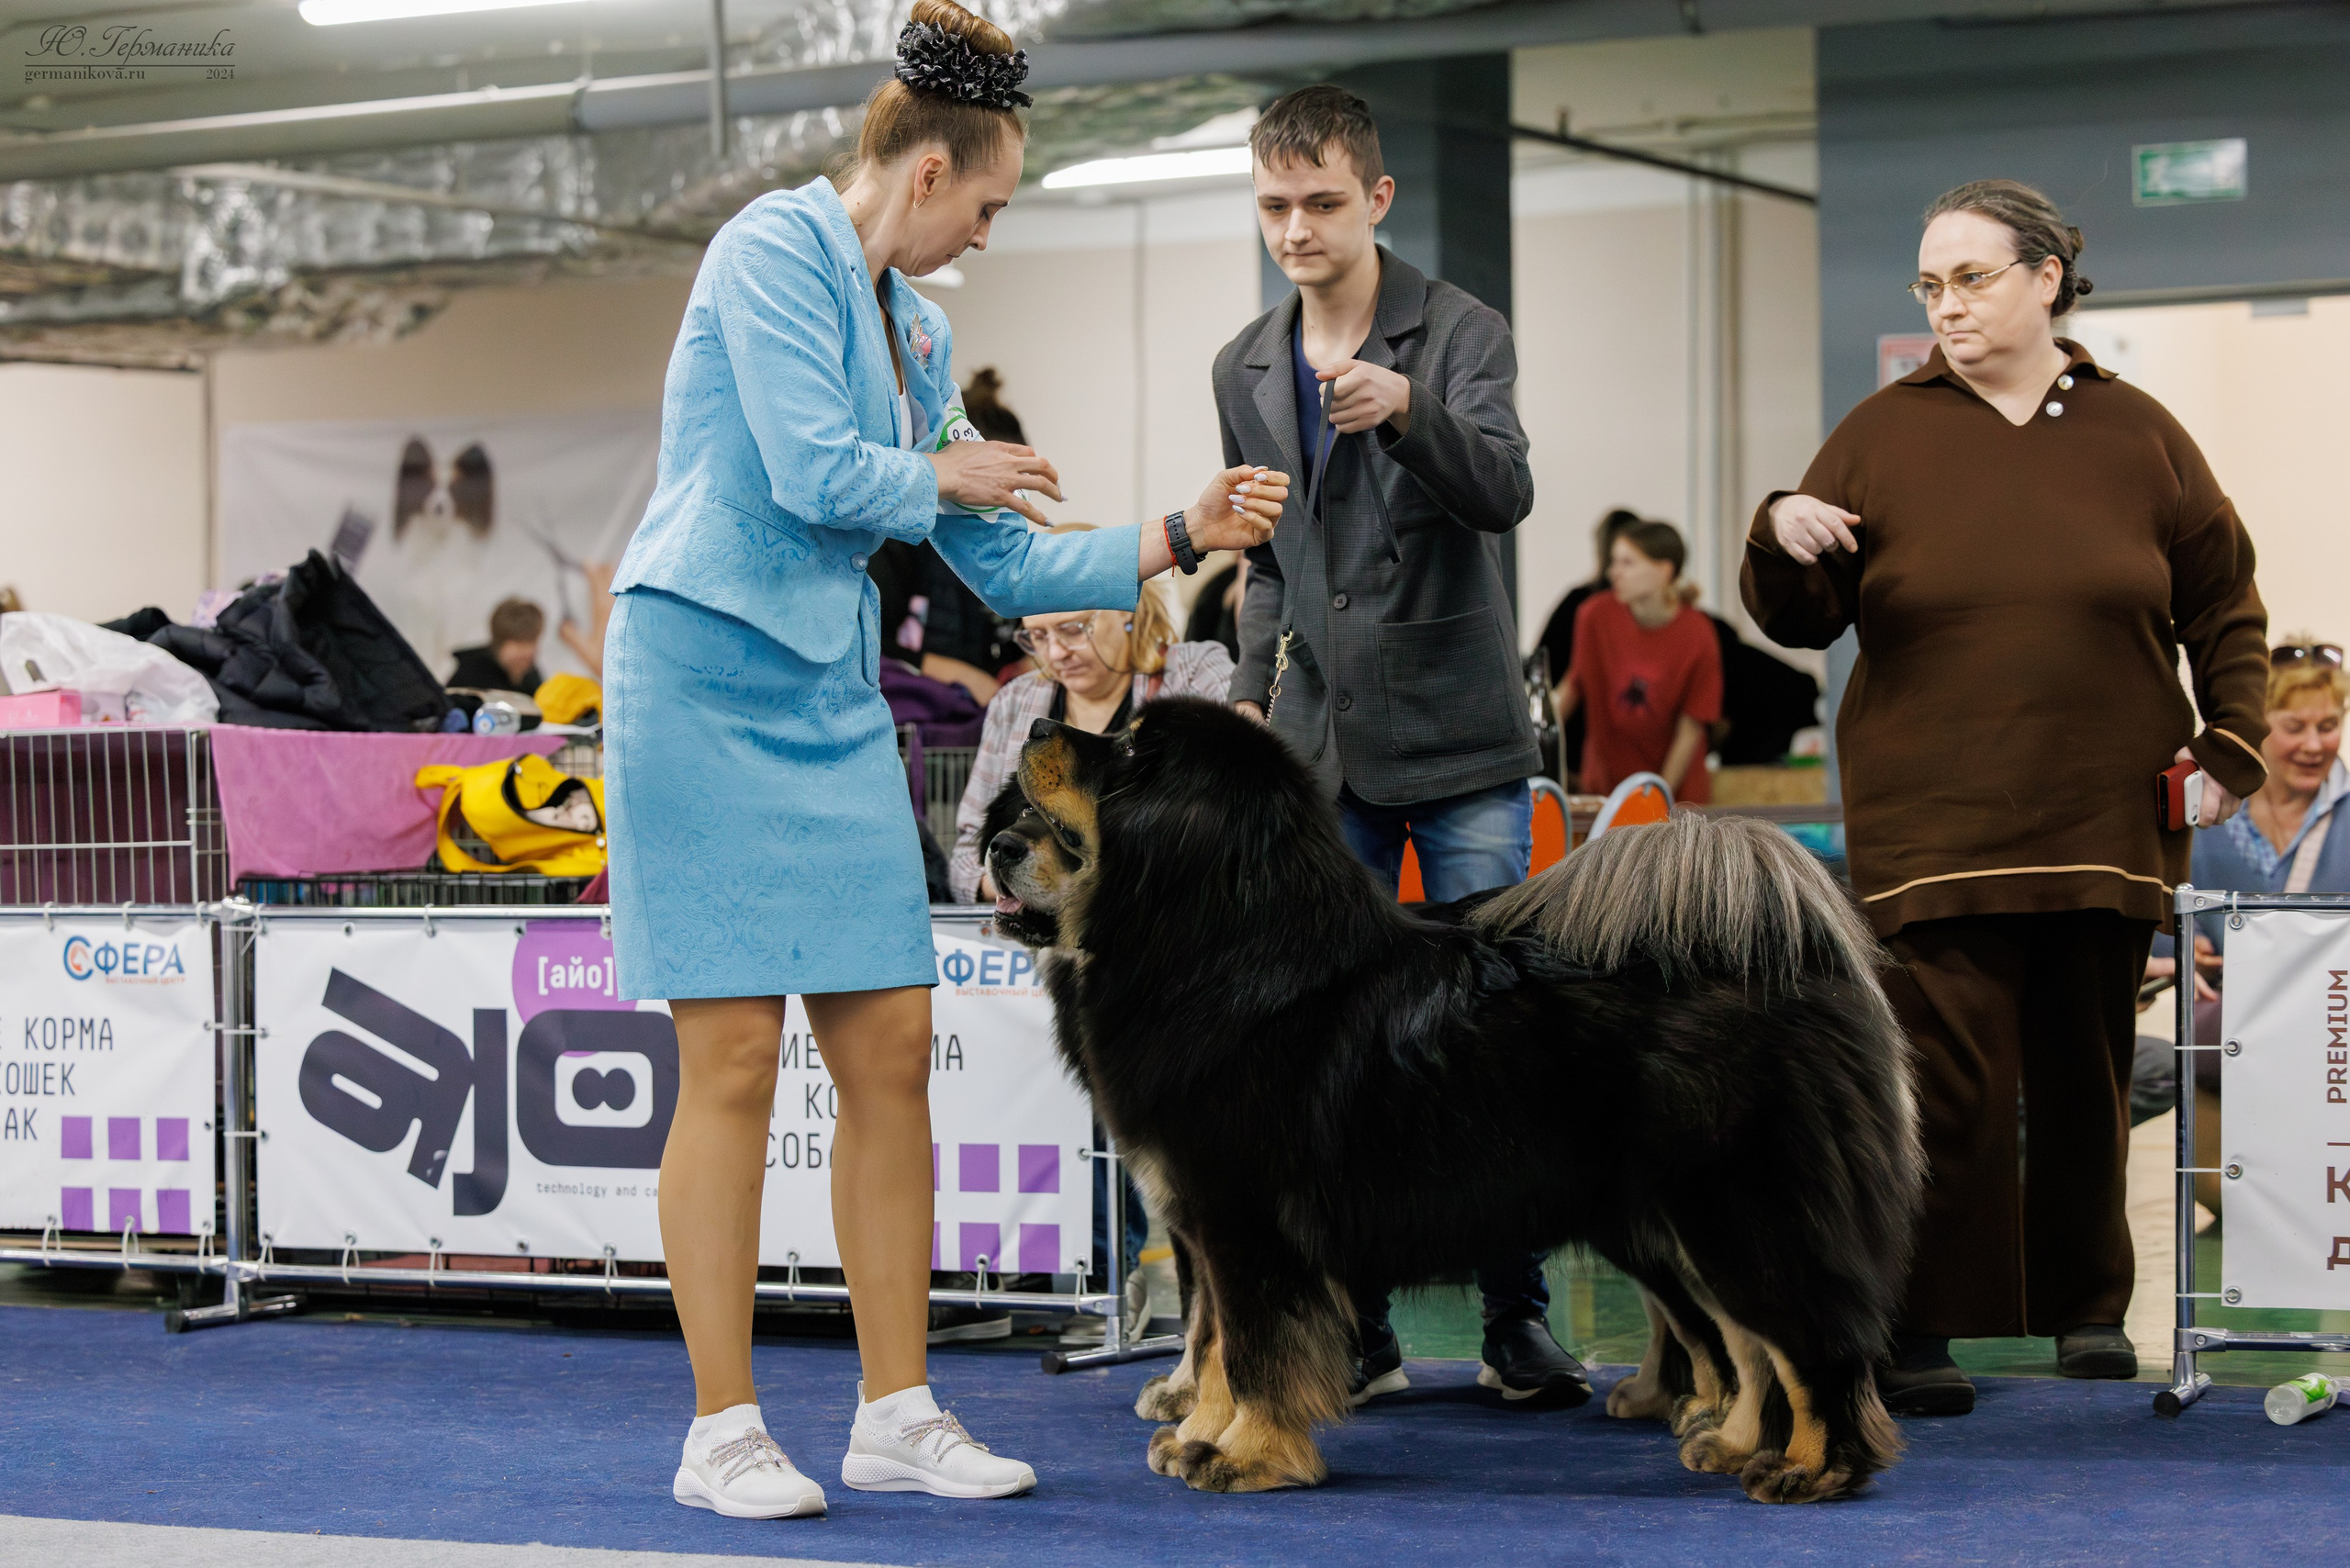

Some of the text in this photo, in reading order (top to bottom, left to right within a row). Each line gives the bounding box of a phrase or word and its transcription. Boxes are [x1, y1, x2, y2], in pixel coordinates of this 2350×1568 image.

[63, 935, 186, 981] СФЕРА
[934, 948, 1041, 987] ФЕР
[956, 986, 1028, 997] ВЫСТАВОЧНЫЙ
[25, 1017, 113, 1051] КОРМА
[2327, 969, 2348, 1103] PREMIUM
[0, 1061, 75, 1096] ОШЕК
[536, 1182, 608, 1198] technology
[616, 1185, 637, 1196] and
